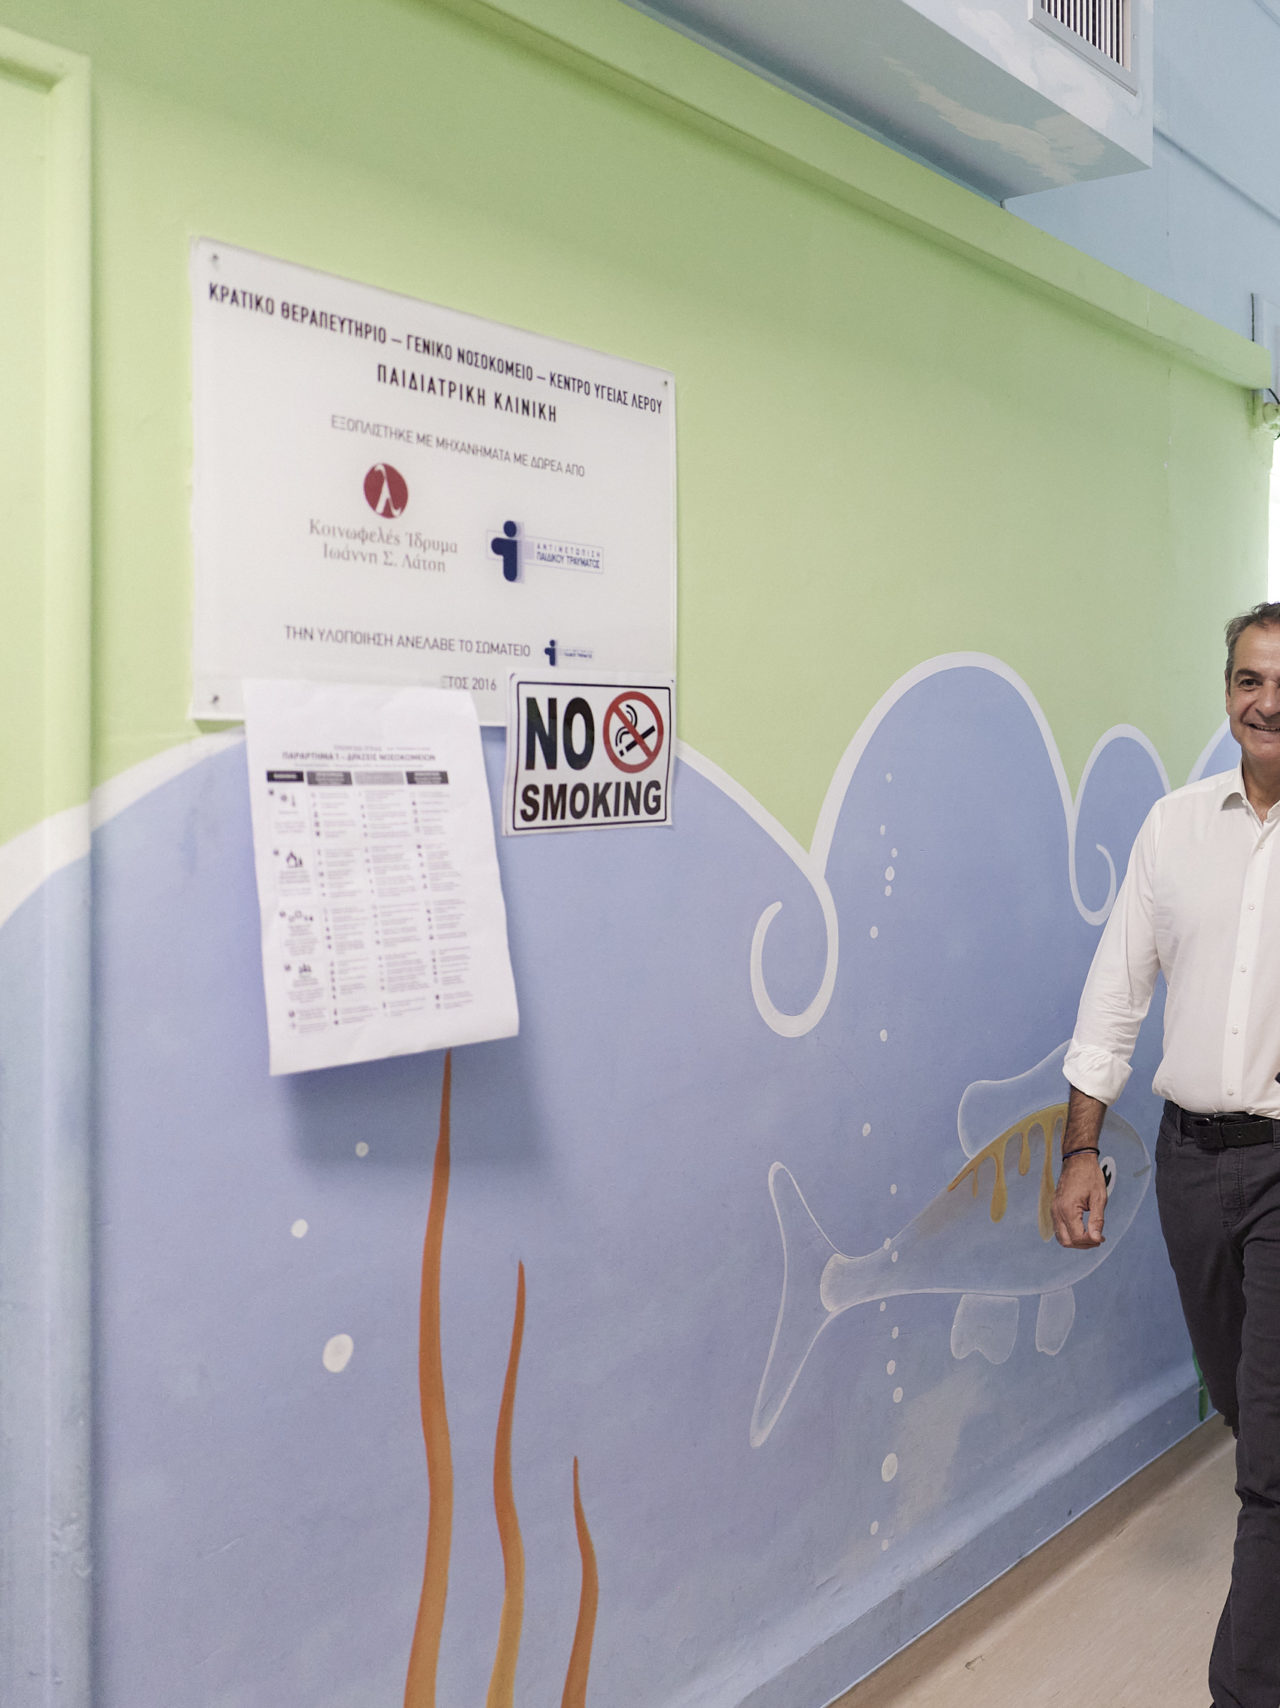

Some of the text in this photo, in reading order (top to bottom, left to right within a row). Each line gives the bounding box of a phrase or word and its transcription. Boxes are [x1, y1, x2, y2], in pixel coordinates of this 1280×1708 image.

[208, 282, 275, 315] ΚΡΑΤΙΚΟ
[280, 301, 387, 344] ΘΕΡΑΠΕΥΤΗΡΙΟ
[406, 334, 452, 361] ΓΕΝΙΚΟ
[457, 346, 533, 381] ΝΟΣΟΚΟΜΕΙΟ
[549, 371, 591, 396] ΚΕΝΤΡΟ
[594, 383, 629, 406] ΥΓΕΙΑΣ
[631, 394, 663, 414] ΛΕΡΟΥ
[377, 363, 557, 423] ΠΑΙΔΙΑΤΡΙΚΗ ΚΛΙΝΙΚΗ
[331, 414, 585, 478] ΕΞΟΠΛΙΣΤΗΚΕ ΜΕ ΜΗΧΑΝΗΜΑΤΑ ΜΕ ΔΩΡΕΑ ΑΠΟ
[309, 518, 458, 556] Κοινωφελές Ίδρυμα
[323, 542, 377, 565] Ιωάννη
[284, 625, 531, 657] ΤΗΝ ΥΛΟΠΟΙΗΣΗ ΑΝΕΛΑΒΕ ΤΟ ΣΩΜΑΤΕΙΟ
[472, 677, 497, 691] 2016
[525, 697, 595, 771] NO
[520, 780, 662, 822] SMOKING
